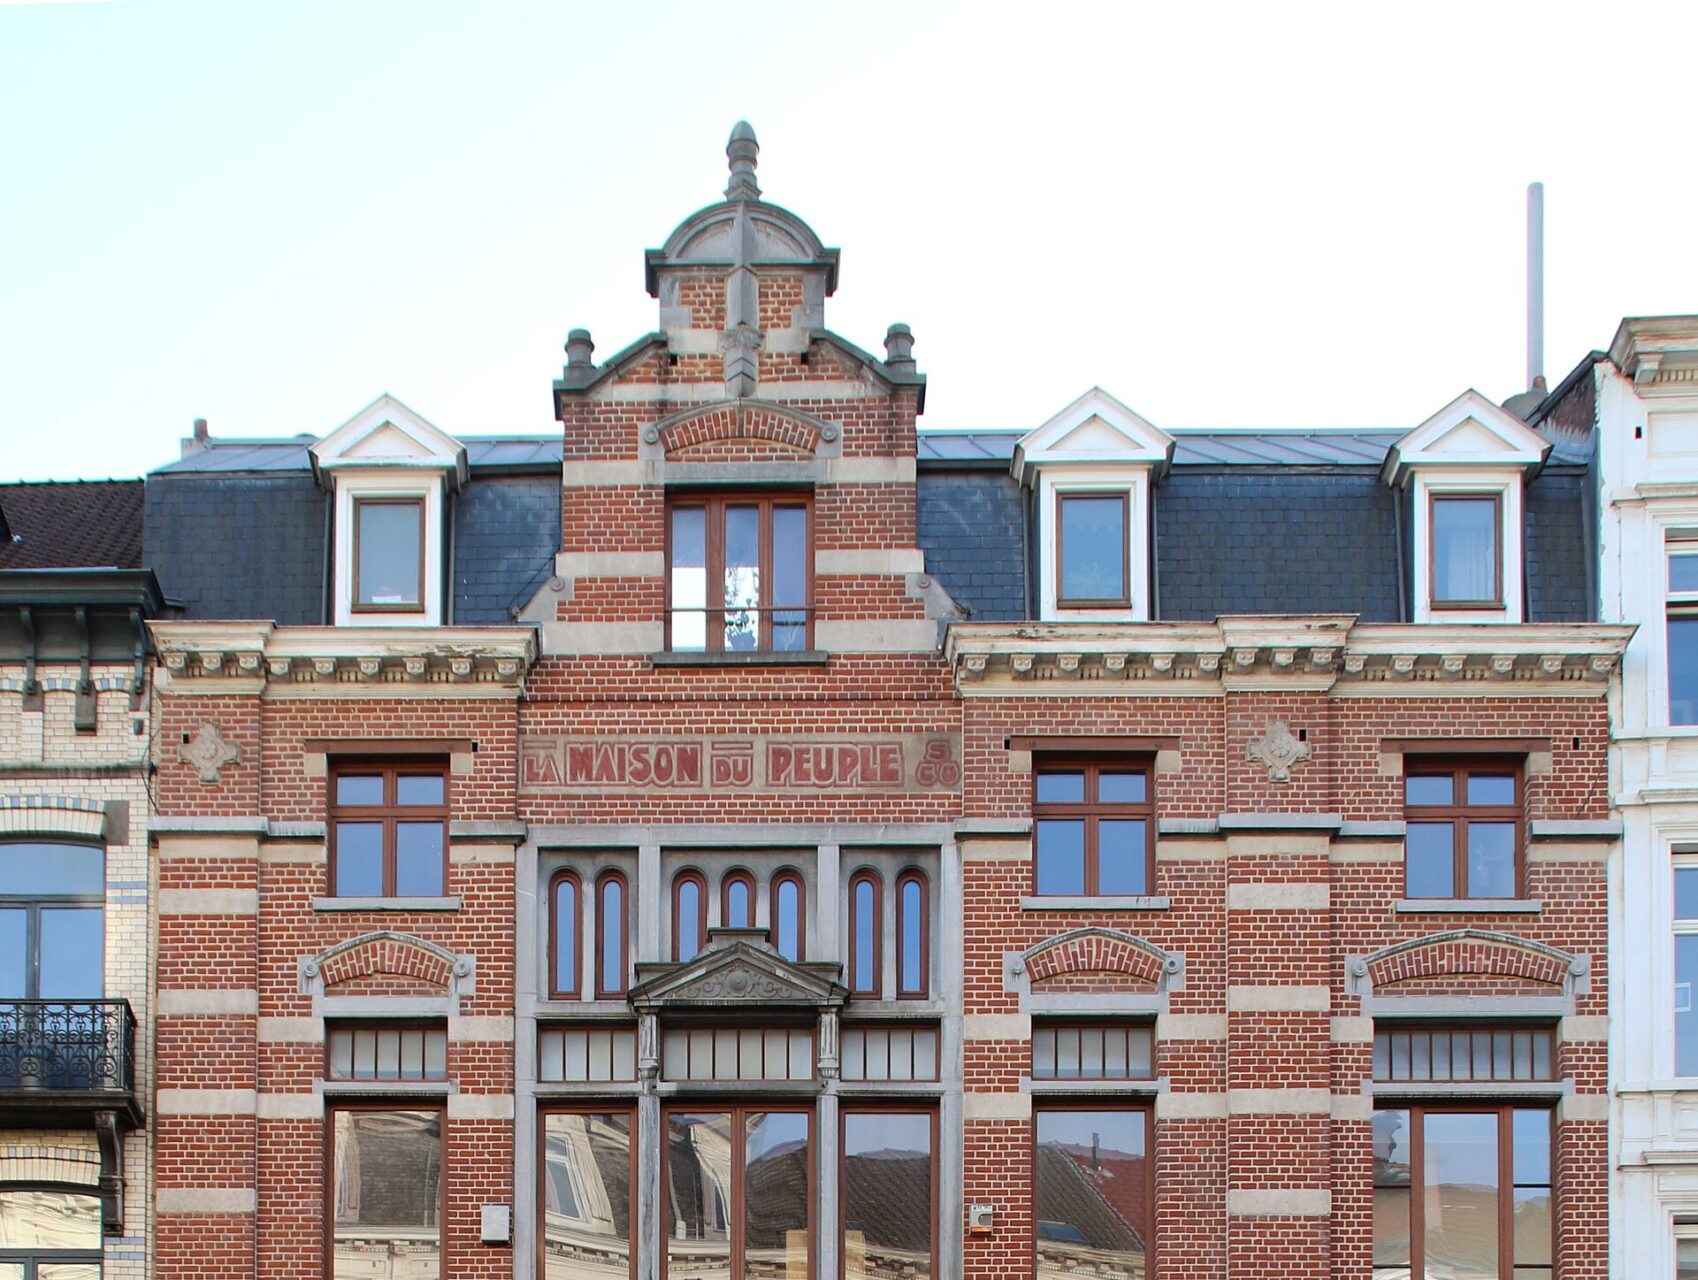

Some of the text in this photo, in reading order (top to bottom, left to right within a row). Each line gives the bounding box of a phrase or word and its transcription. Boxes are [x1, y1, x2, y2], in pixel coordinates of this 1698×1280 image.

[524, 743, 902, 786] LA MAISON DU PEUPLE
